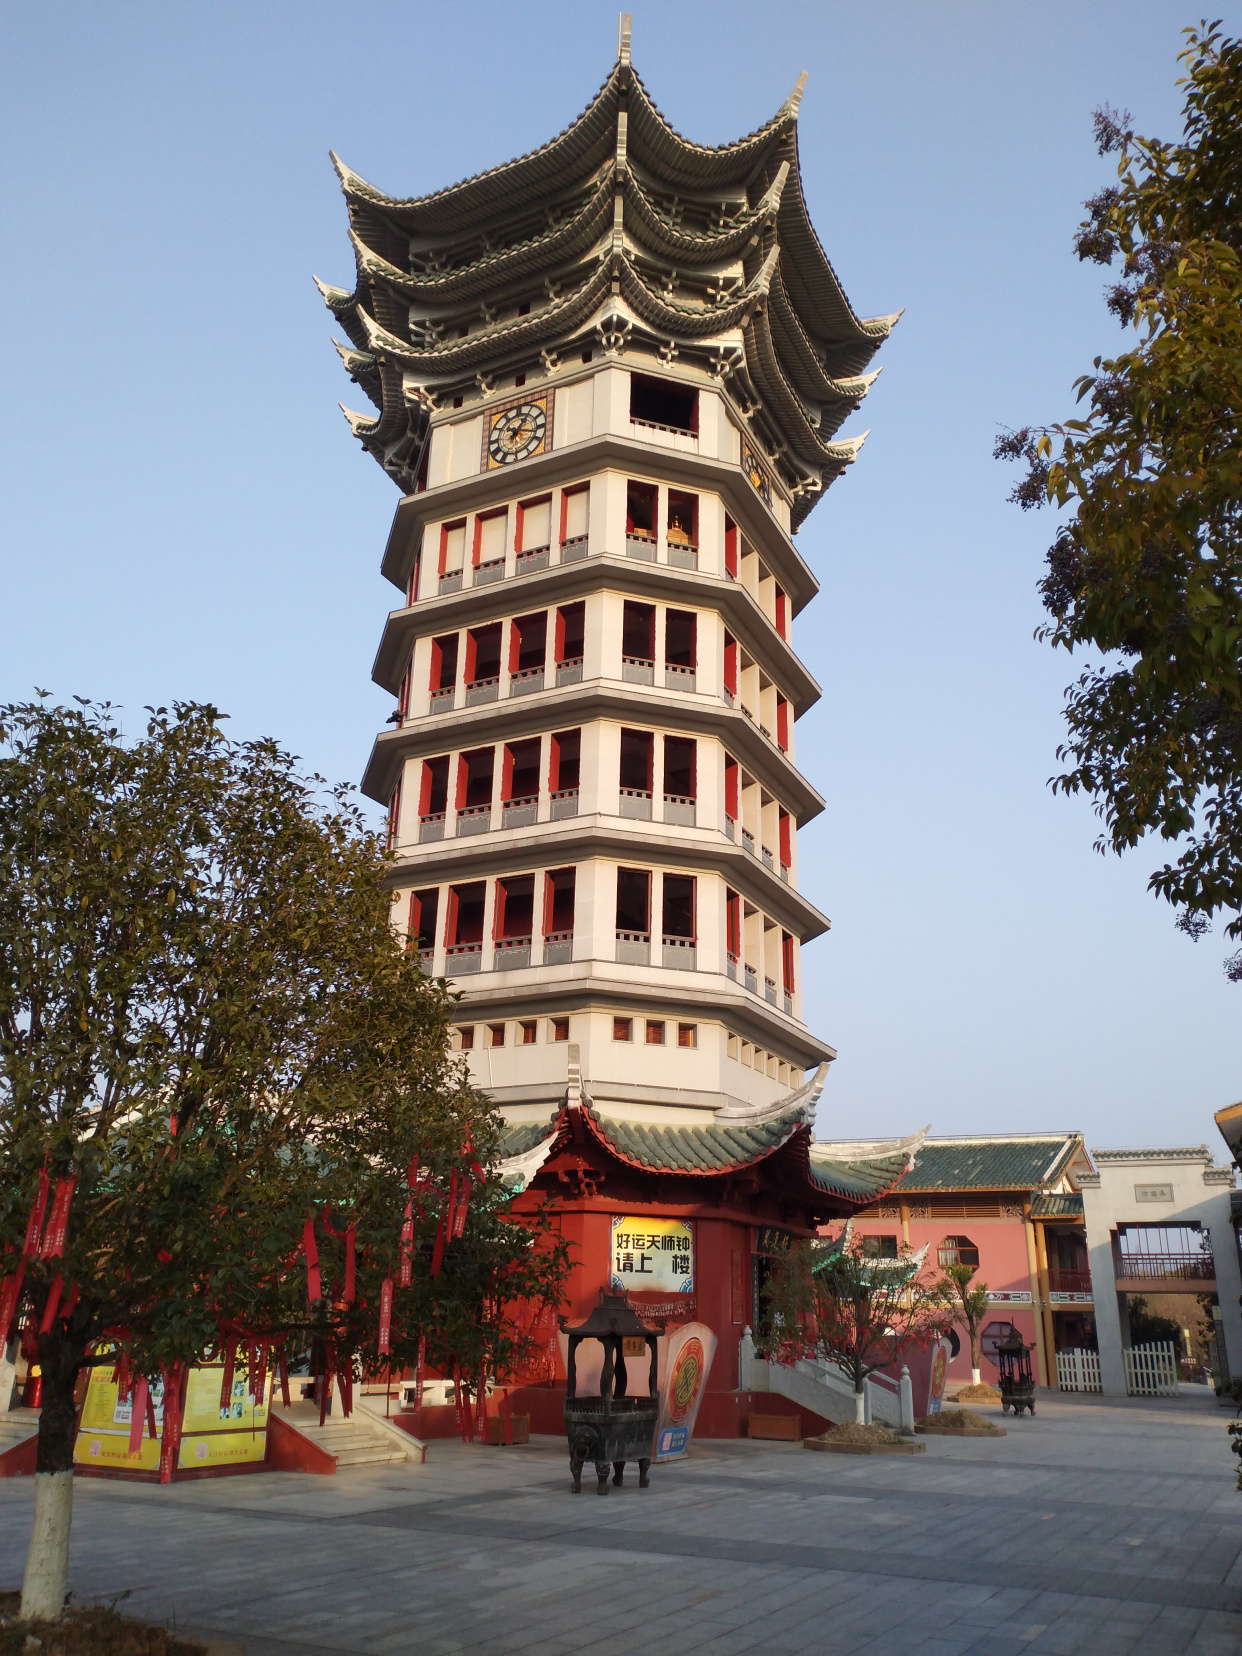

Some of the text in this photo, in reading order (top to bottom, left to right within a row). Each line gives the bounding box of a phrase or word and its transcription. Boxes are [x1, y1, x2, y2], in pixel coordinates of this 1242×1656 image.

[616, 1233, 690, 1251] 好运天师钟
[616, 1252, 690, 1275] 请上 楼
